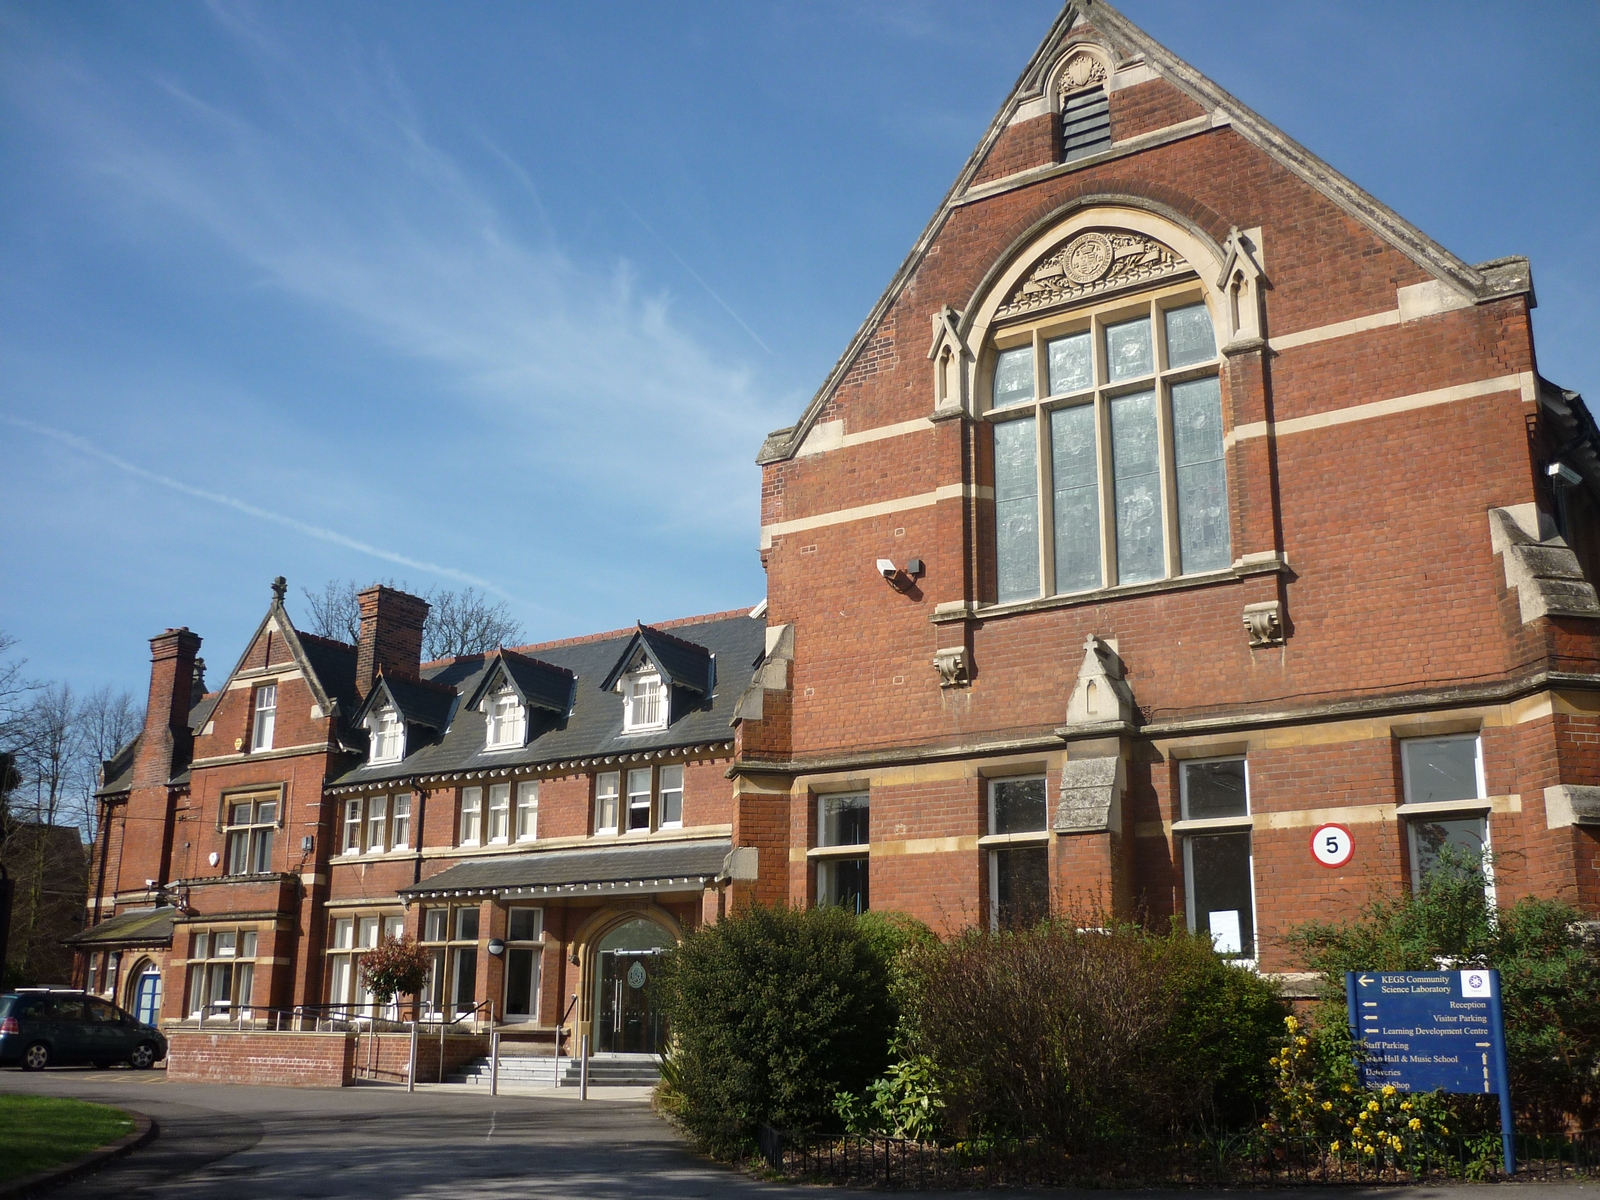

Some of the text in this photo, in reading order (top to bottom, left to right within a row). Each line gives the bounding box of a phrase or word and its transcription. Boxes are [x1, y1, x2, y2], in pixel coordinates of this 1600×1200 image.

[1326, 836, 1338, 854] 5
[1406, 975, 1450, 984] Community
[1411, 986, 1451, 994] Laboratory
[1450, 1001, 1486, 1010] Reception
[1459, 1015, 1487, 1023] Parking
[1382, 1042, 1409, 1050] Parking
[1392, 1082, 1410, 1090] Shop
